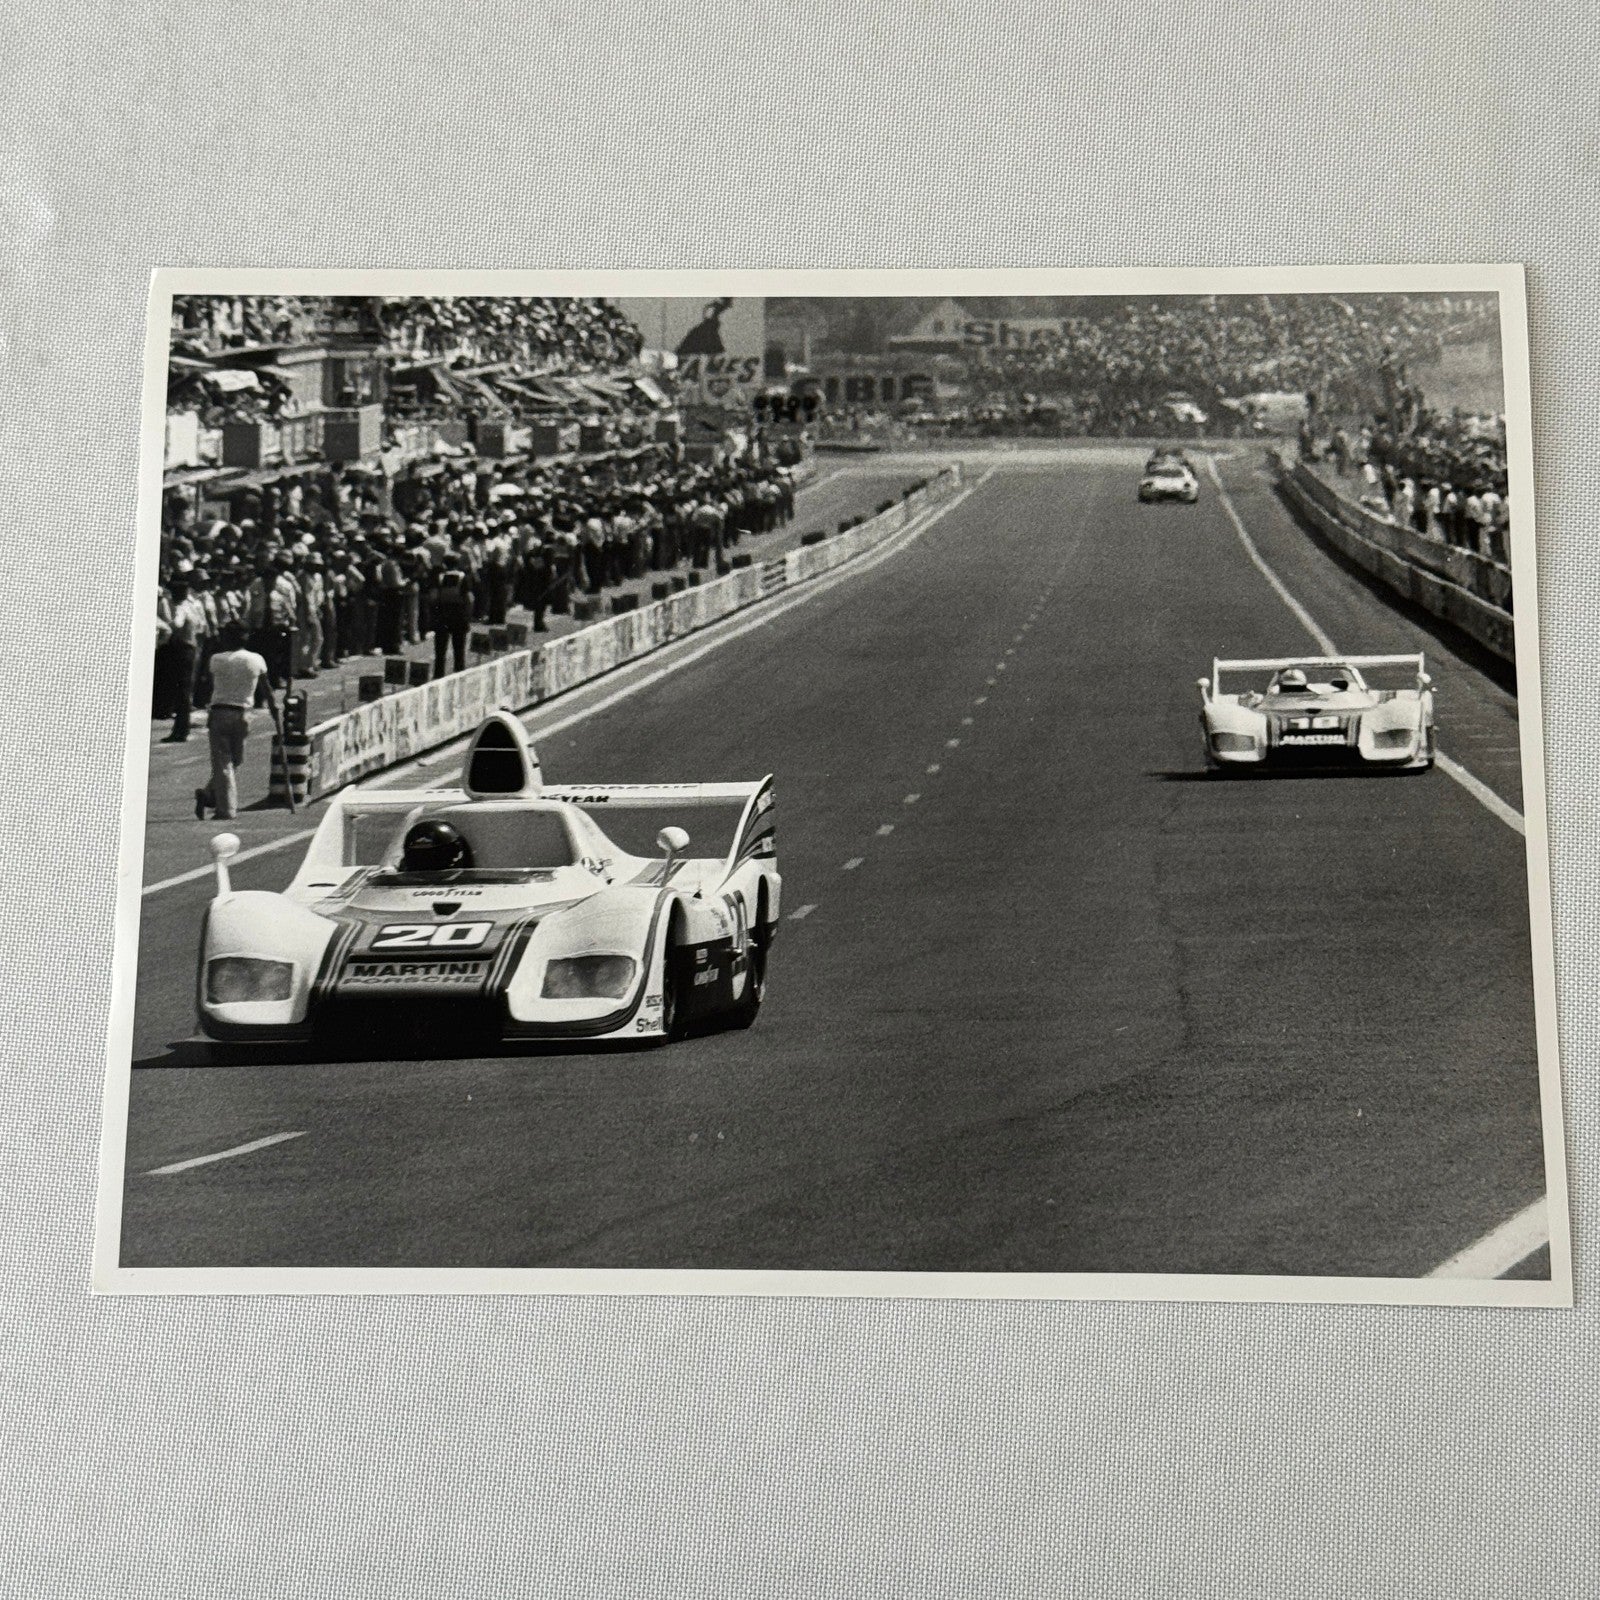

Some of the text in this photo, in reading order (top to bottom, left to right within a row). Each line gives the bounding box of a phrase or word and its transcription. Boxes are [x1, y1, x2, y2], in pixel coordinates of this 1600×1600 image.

[371, 921, 495, 948] 20
[353, 962, 482, 977] MARTINI
[343, 974, 484, 985] PORSCHE
[636, 1017, 664, 1033] Shell
